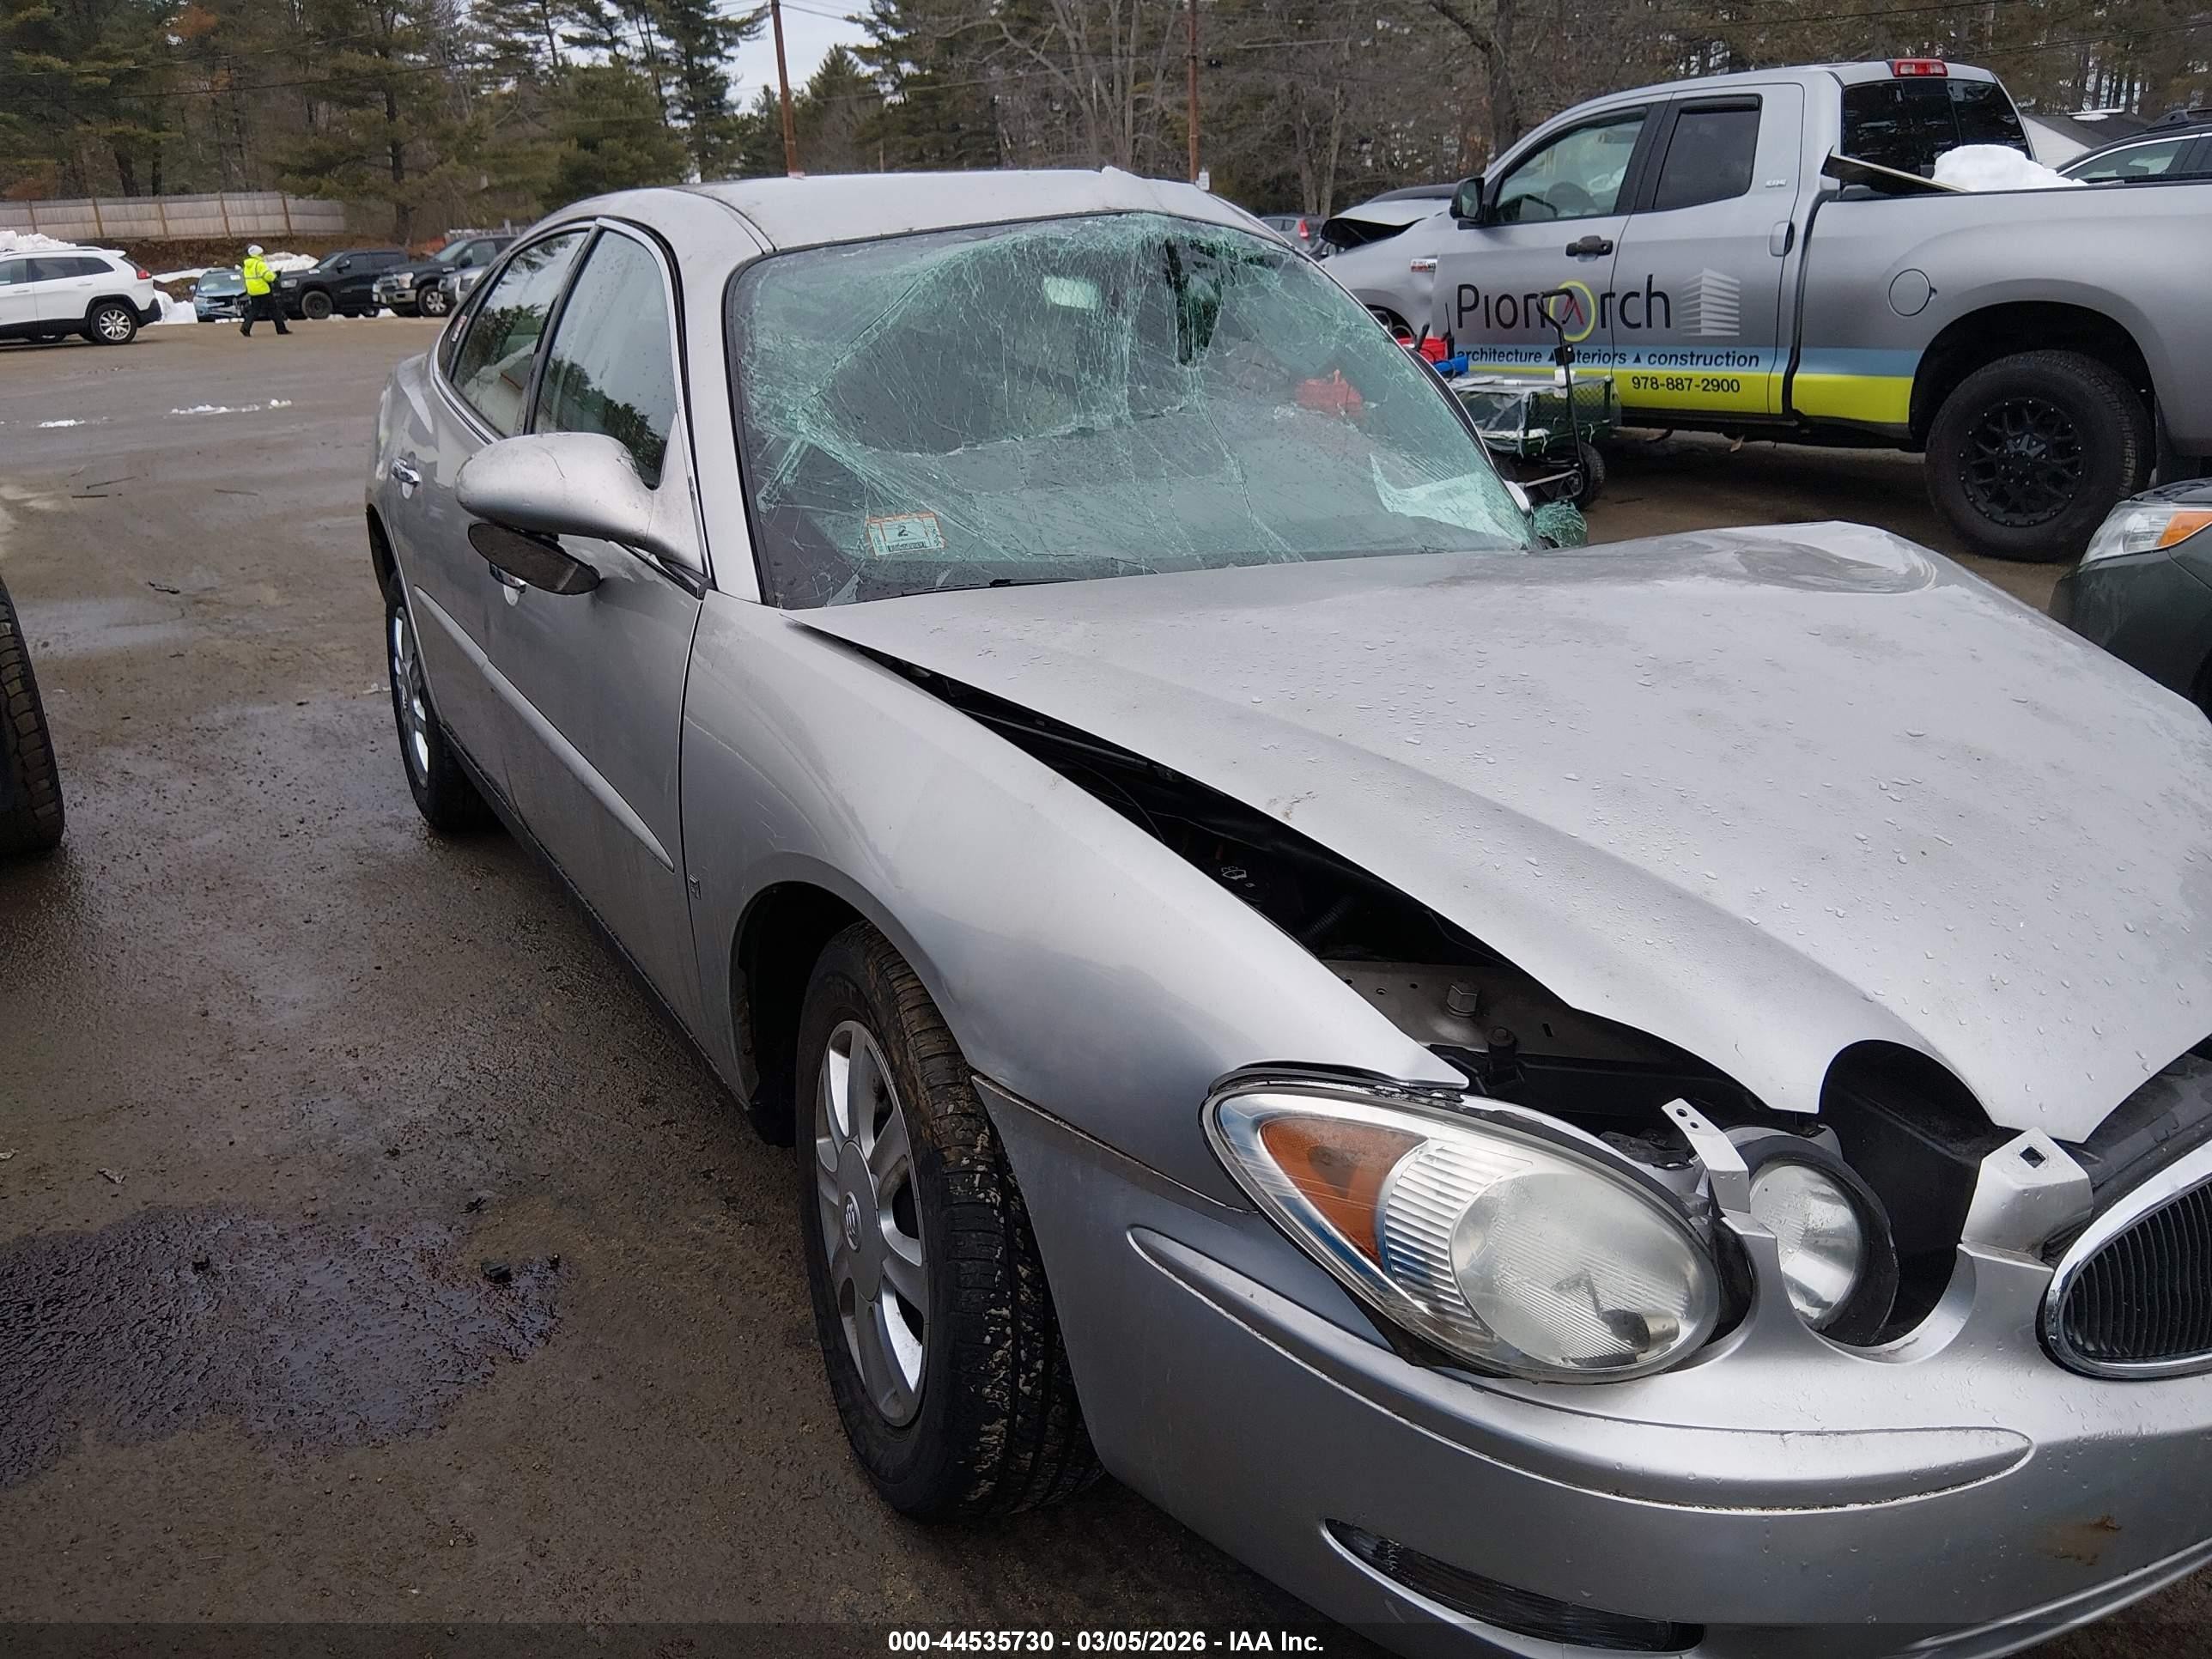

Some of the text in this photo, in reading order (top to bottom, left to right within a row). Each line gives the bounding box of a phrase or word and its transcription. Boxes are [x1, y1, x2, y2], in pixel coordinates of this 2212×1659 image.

[1456, 347, 1542, 363] architecture
[1648, 350, 1759, 368] construction
[1632, 375, 1741, 392] 978-887-2900
[897, 525, 908, 538] 2
